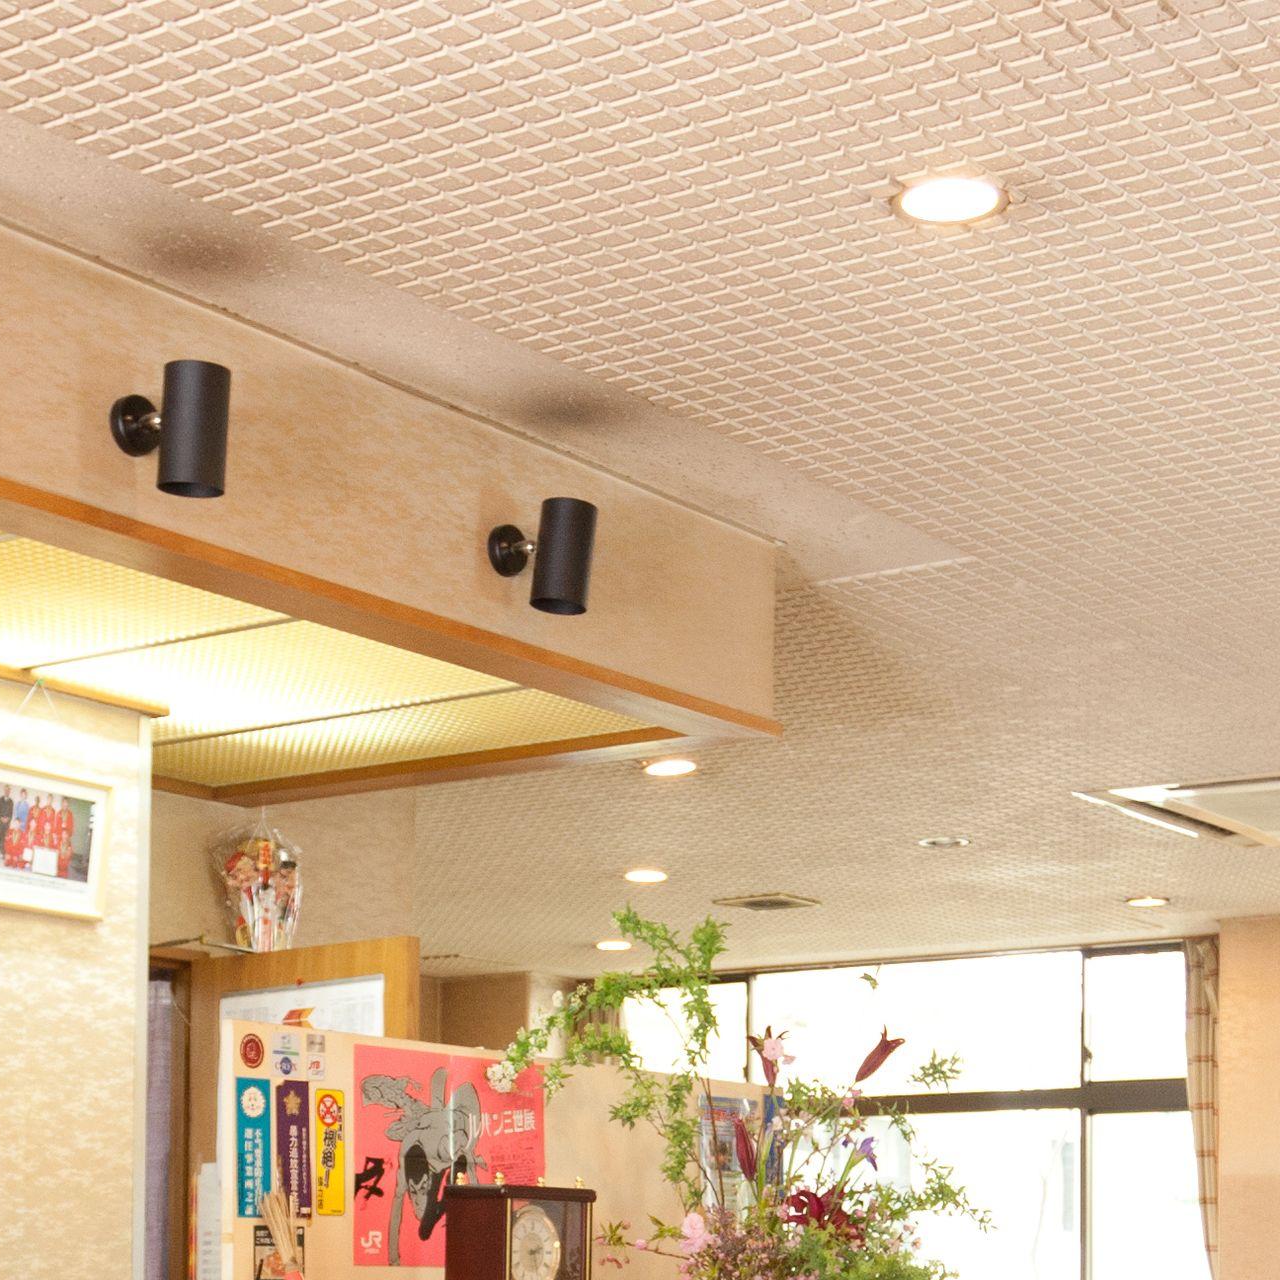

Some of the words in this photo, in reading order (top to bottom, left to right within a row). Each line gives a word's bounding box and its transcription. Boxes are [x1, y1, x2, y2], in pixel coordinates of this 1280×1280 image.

[465, 1109, 535, 1150] ルパン三世展
[361, 1231, 382, 1248] JR
